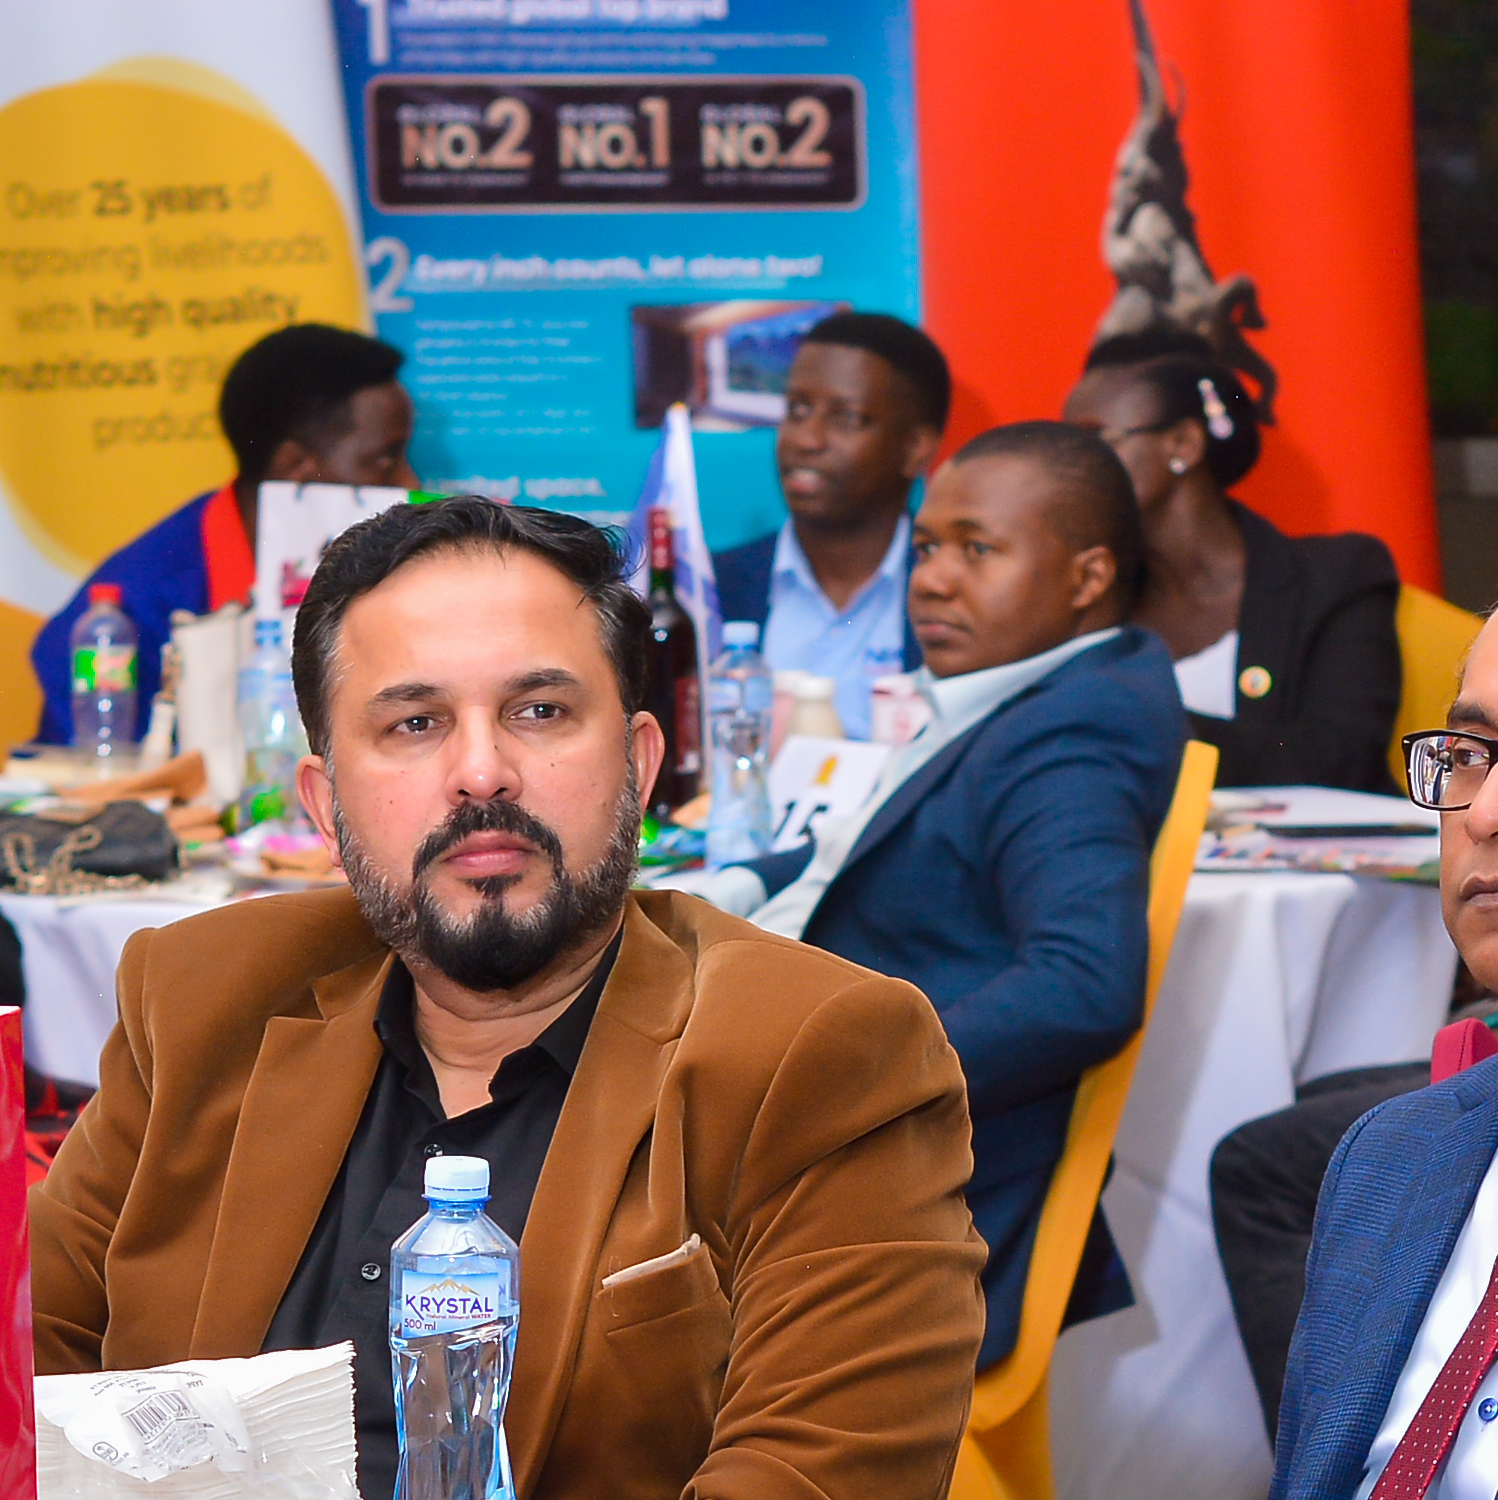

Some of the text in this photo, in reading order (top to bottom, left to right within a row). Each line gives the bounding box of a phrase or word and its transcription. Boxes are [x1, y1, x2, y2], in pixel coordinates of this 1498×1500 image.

[400, 97, 534, 170] NO.2
[558, 97, 670, 170] NO.1
[700, 97, 832, 170] NO.2
[92, 182, 133, 216] 25
[141, 183, 229, 222] years
[368, 238, 412, 312] 2
[92, 299, 174, 337] high
[181, 290, 298, 334] quality
[404, 1318, 436, 1331] 500 ml
[405, 1294, 494, 1321] KRYSTAL
